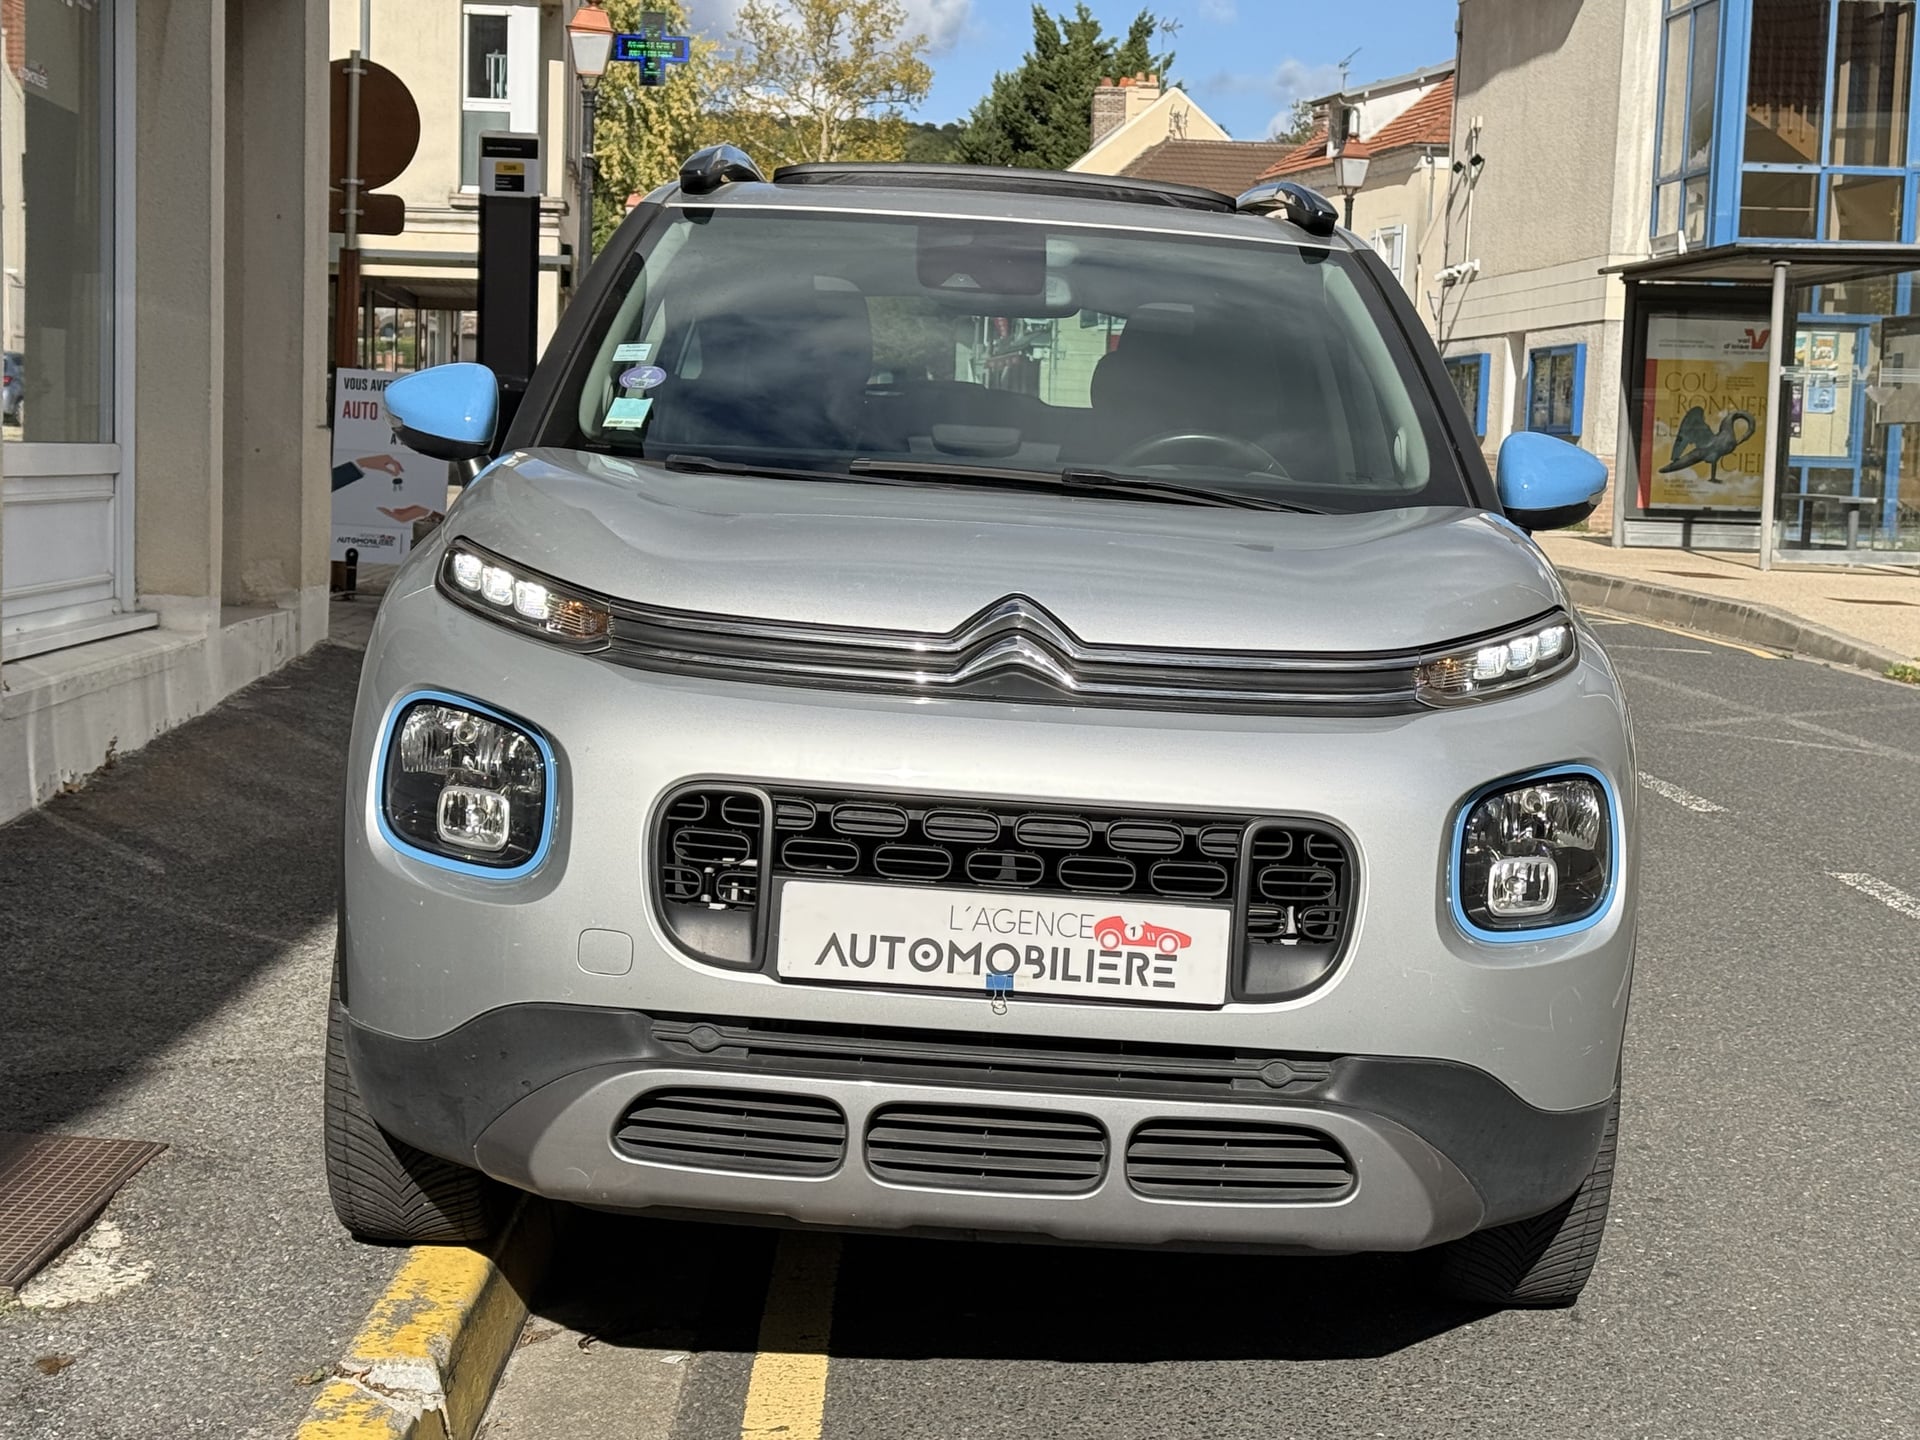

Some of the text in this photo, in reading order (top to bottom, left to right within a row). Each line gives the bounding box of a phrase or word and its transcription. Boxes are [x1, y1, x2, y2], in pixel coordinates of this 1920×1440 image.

[344, 377, 368, 391] VOUS
[1665, 371, 1718, 393] COU
[342, 400, 378, 421] AUTO
[1677, 394, 1768, 417] RONNER
[1656, 416, 1680, 437] LE
[950, 905, 1095, 939] L'AGENCE
[815, 932, 1178, 989] AUTOMOBILIERE
